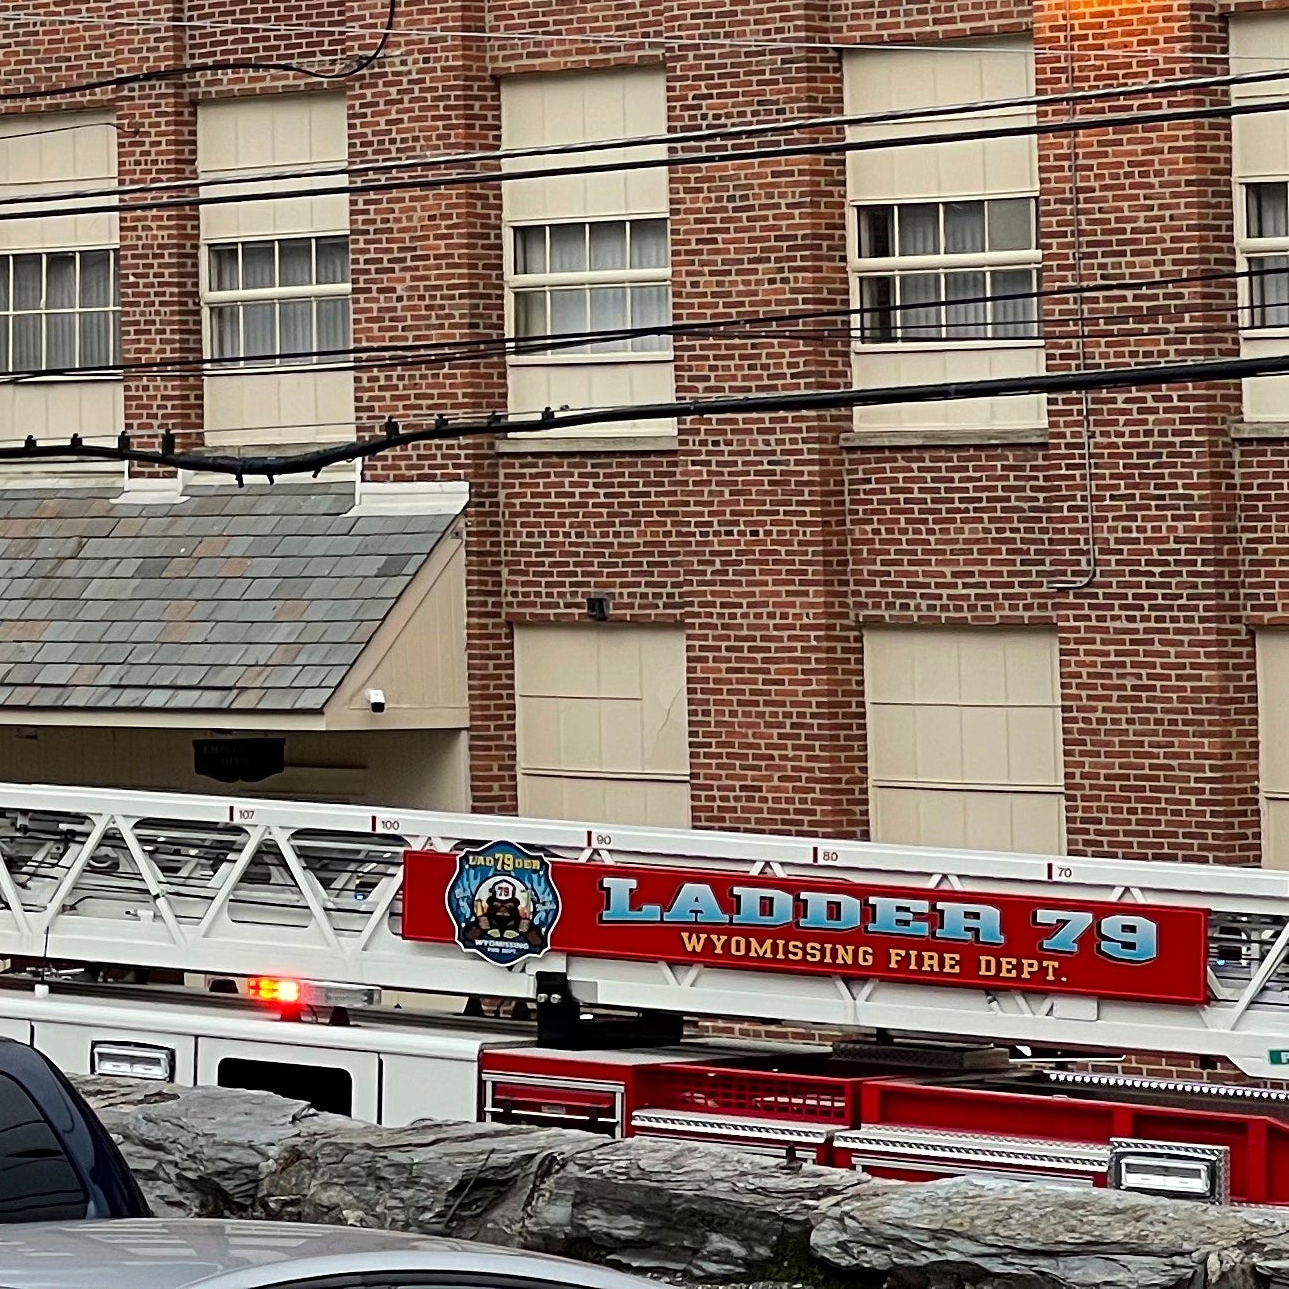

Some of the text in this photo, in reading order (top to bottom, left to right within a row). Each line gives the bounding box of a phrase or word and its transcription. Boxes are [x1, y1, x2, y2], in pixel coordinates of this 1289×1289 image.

[238, 810, 255, 820] 107
[381, 820, 400, 831] 100
[596, 834, 612, 846] 90
[495, 853, 514, 871] 79
[822, 851, 839, 862] 80
[1057, 866, 1073, 878] 70
[599, 877, 1158, 964] LADDER 79
[681, 932, 1068, 982] WYOMISSING FIRE DEPT.
